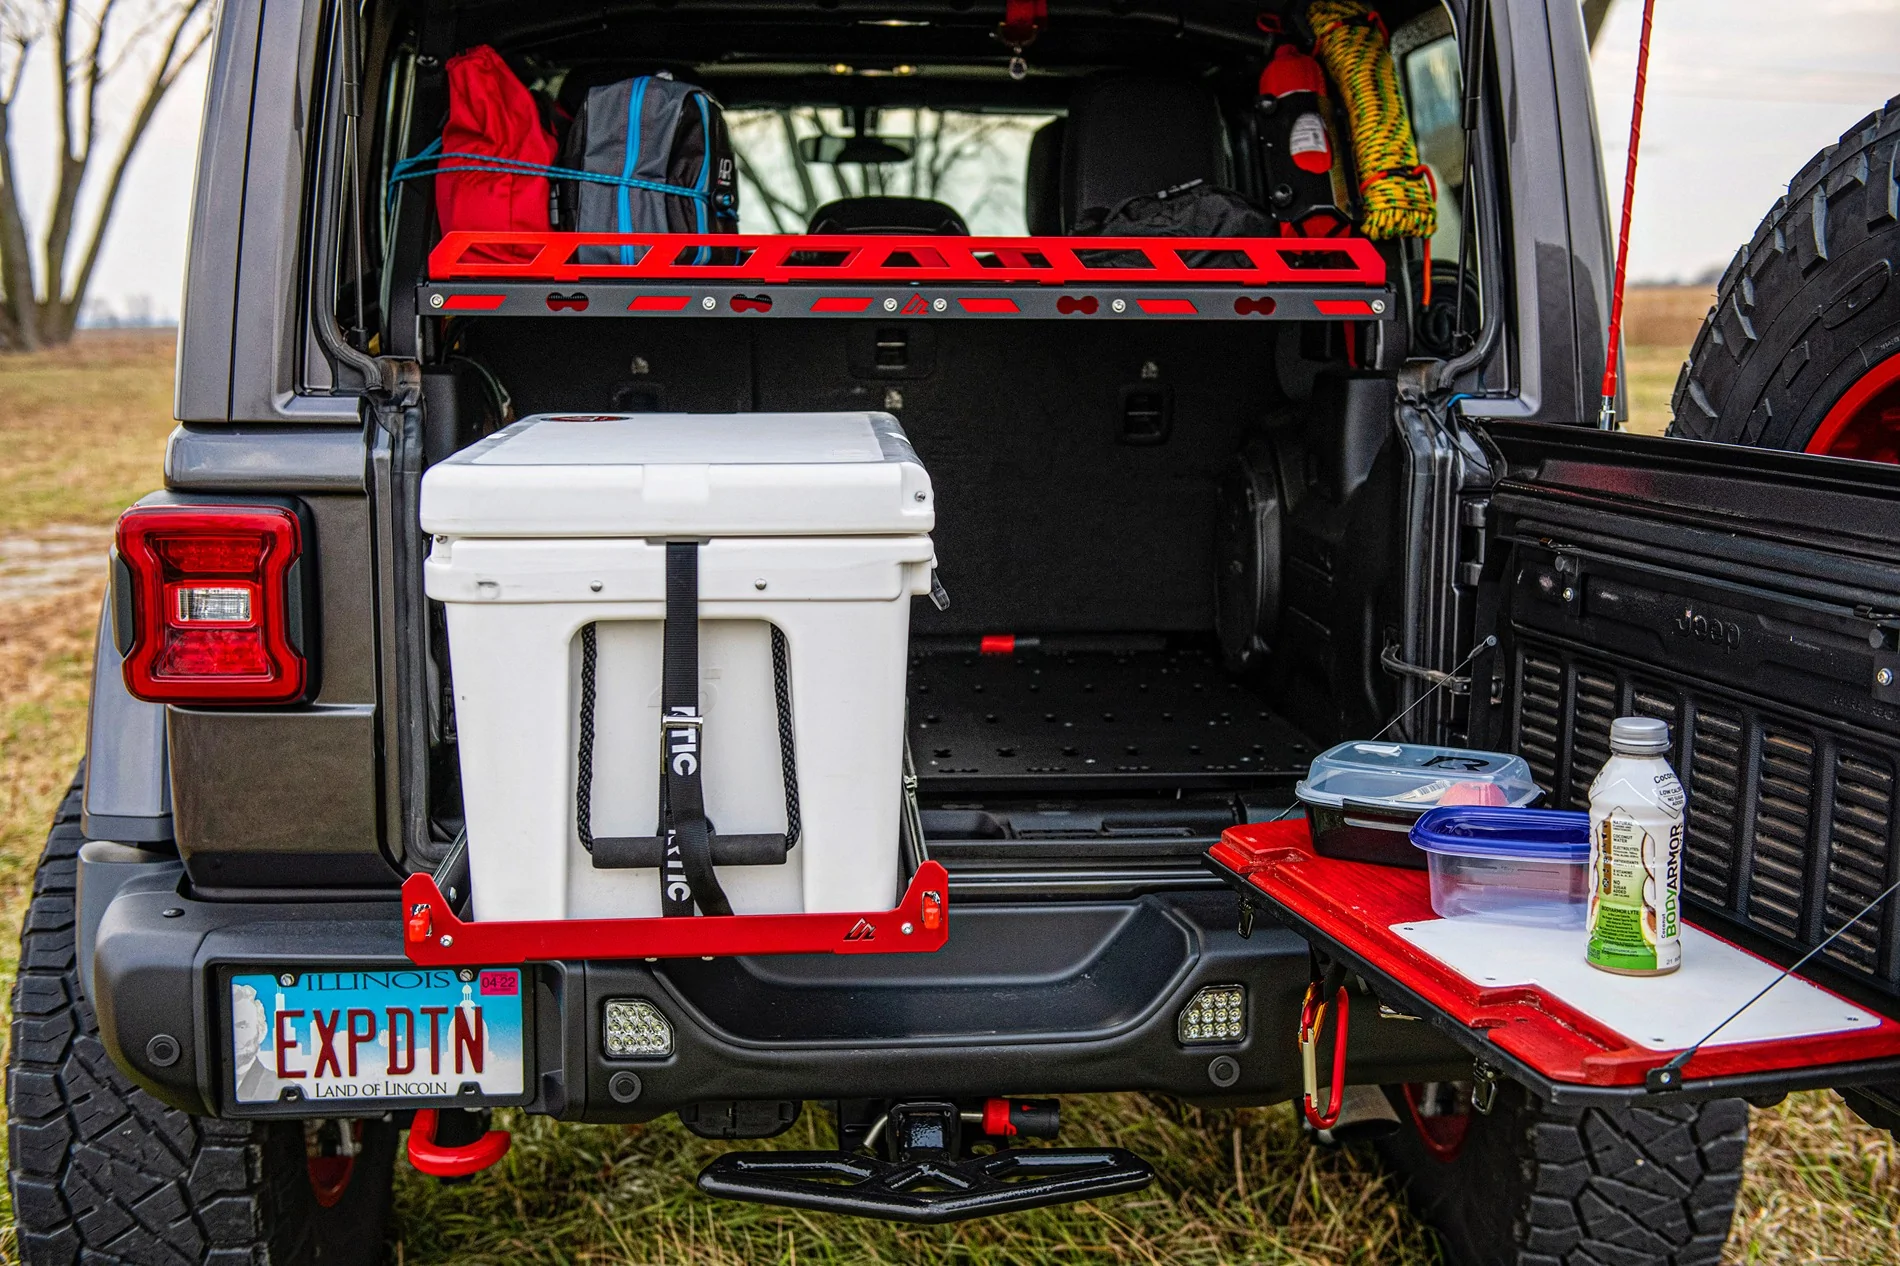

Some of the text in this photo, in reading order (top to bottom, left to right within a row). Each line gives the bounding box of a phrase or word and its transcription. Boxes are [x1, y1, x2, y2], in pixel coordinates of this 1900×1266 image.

[1675, 606, 1740, 654] Jeep
[1665, 823, 1681, 938] BODYARMOR
[306, 971, 451, 991] ILLINOIS
[275, 1006, 484, 1079] EXPDTN
[315, 1082, 358, 1097] LAND
[385, 1081, 447, 1096] LINCOLN
